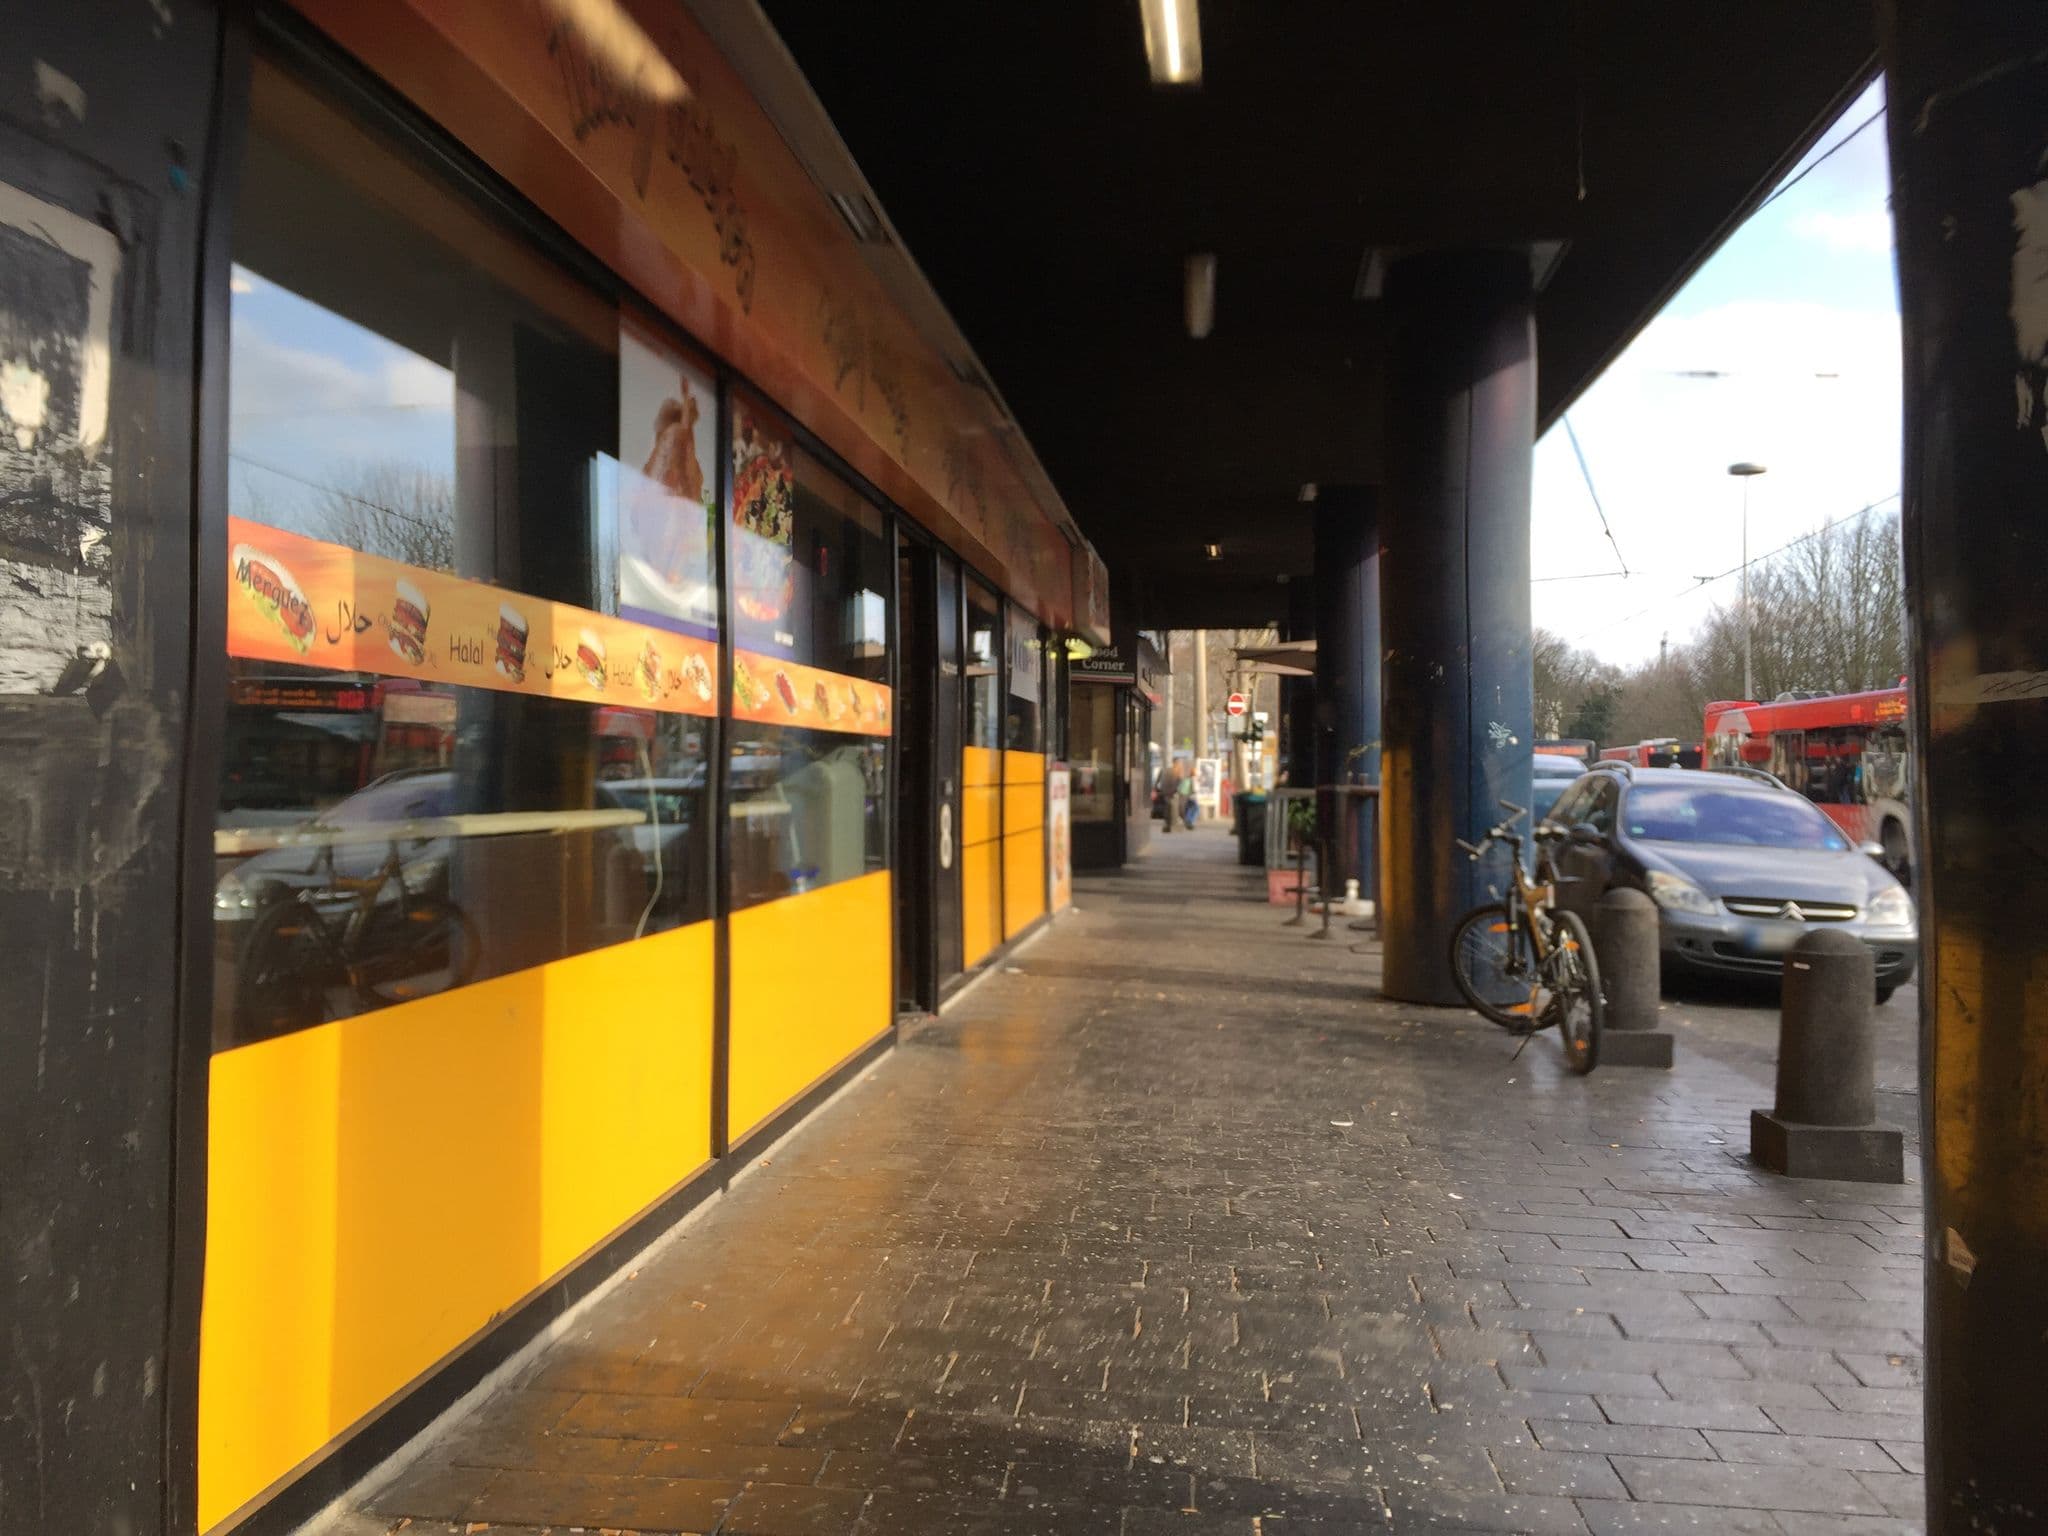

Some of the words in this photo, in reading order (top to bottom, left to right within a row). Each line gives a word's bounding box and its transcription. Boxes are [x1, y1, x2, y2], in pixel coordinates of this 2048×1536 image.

[235, 556, 309, 625] Merguez
[325, 599, 373, 645] حلال
[449, 634, 484, 666] Halal
[1082, 659, 1126, 671] Corner
